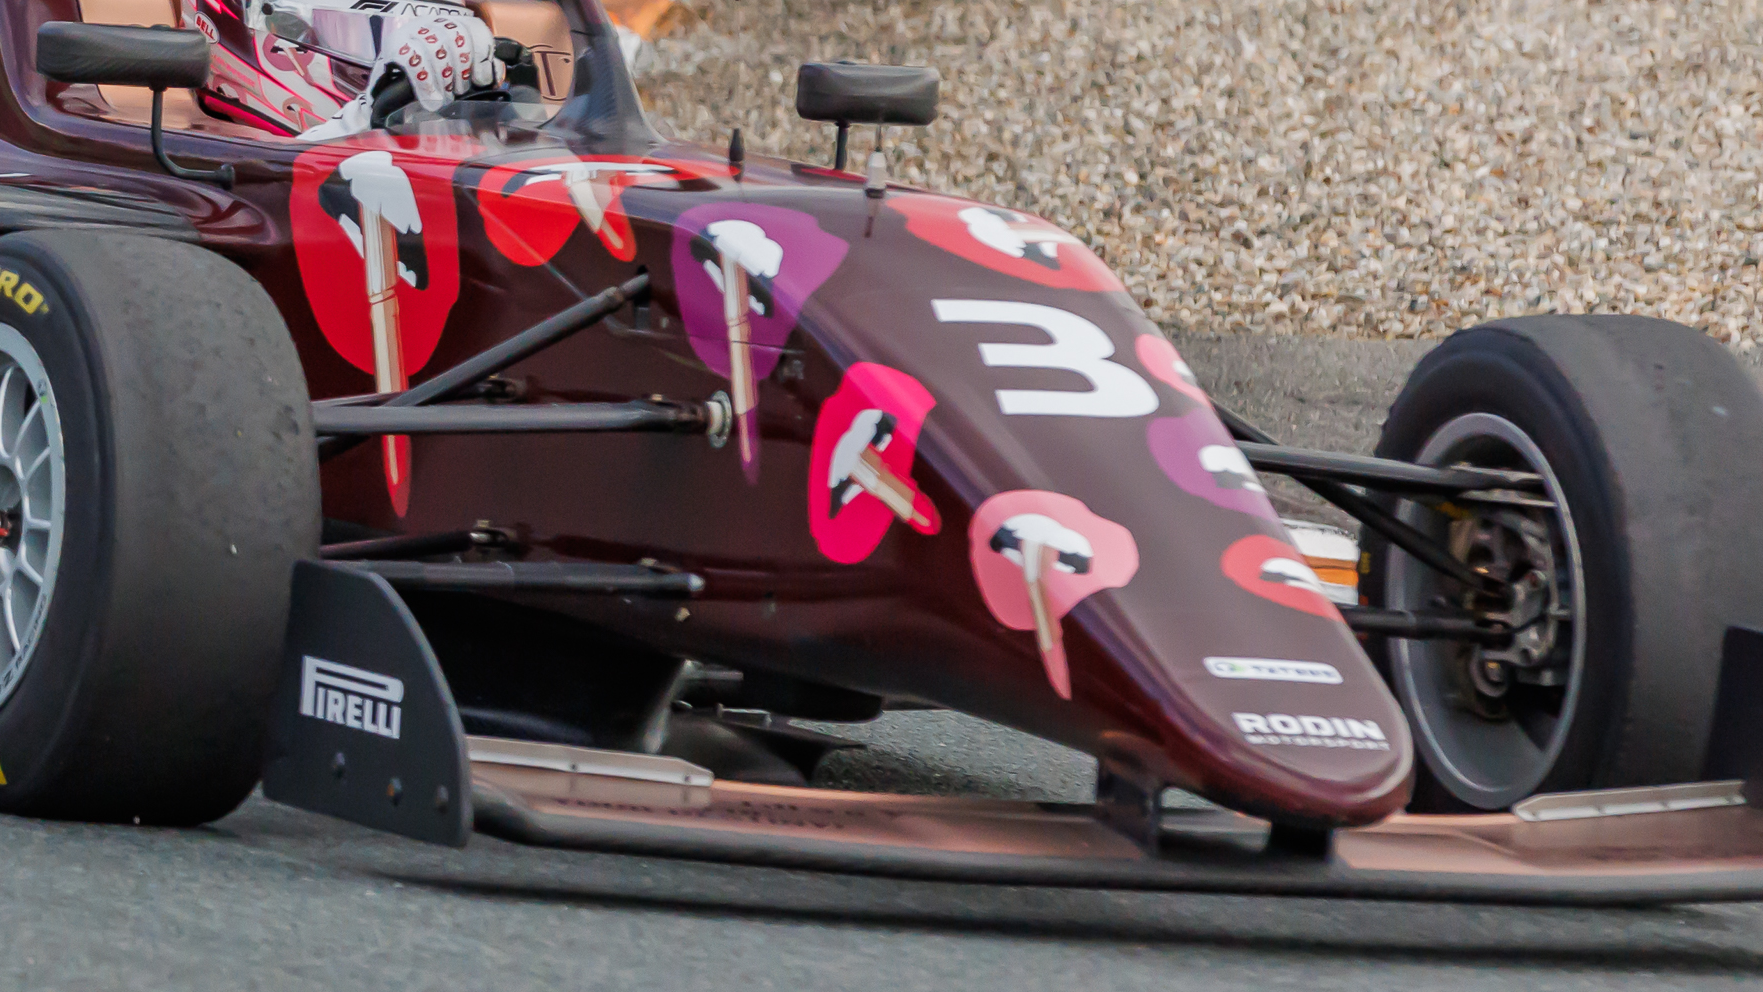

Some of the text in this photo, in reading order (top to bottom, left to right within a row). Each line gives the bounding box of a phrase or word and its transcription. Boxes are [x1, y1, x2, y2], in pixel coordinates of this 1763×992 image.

[196, 15, 215, 40] BELL
[930, 299, 1160, 417] 3
[299, 655, 404, 740] PIRELLI
[1231, 712, 1388, 741] RODIN
